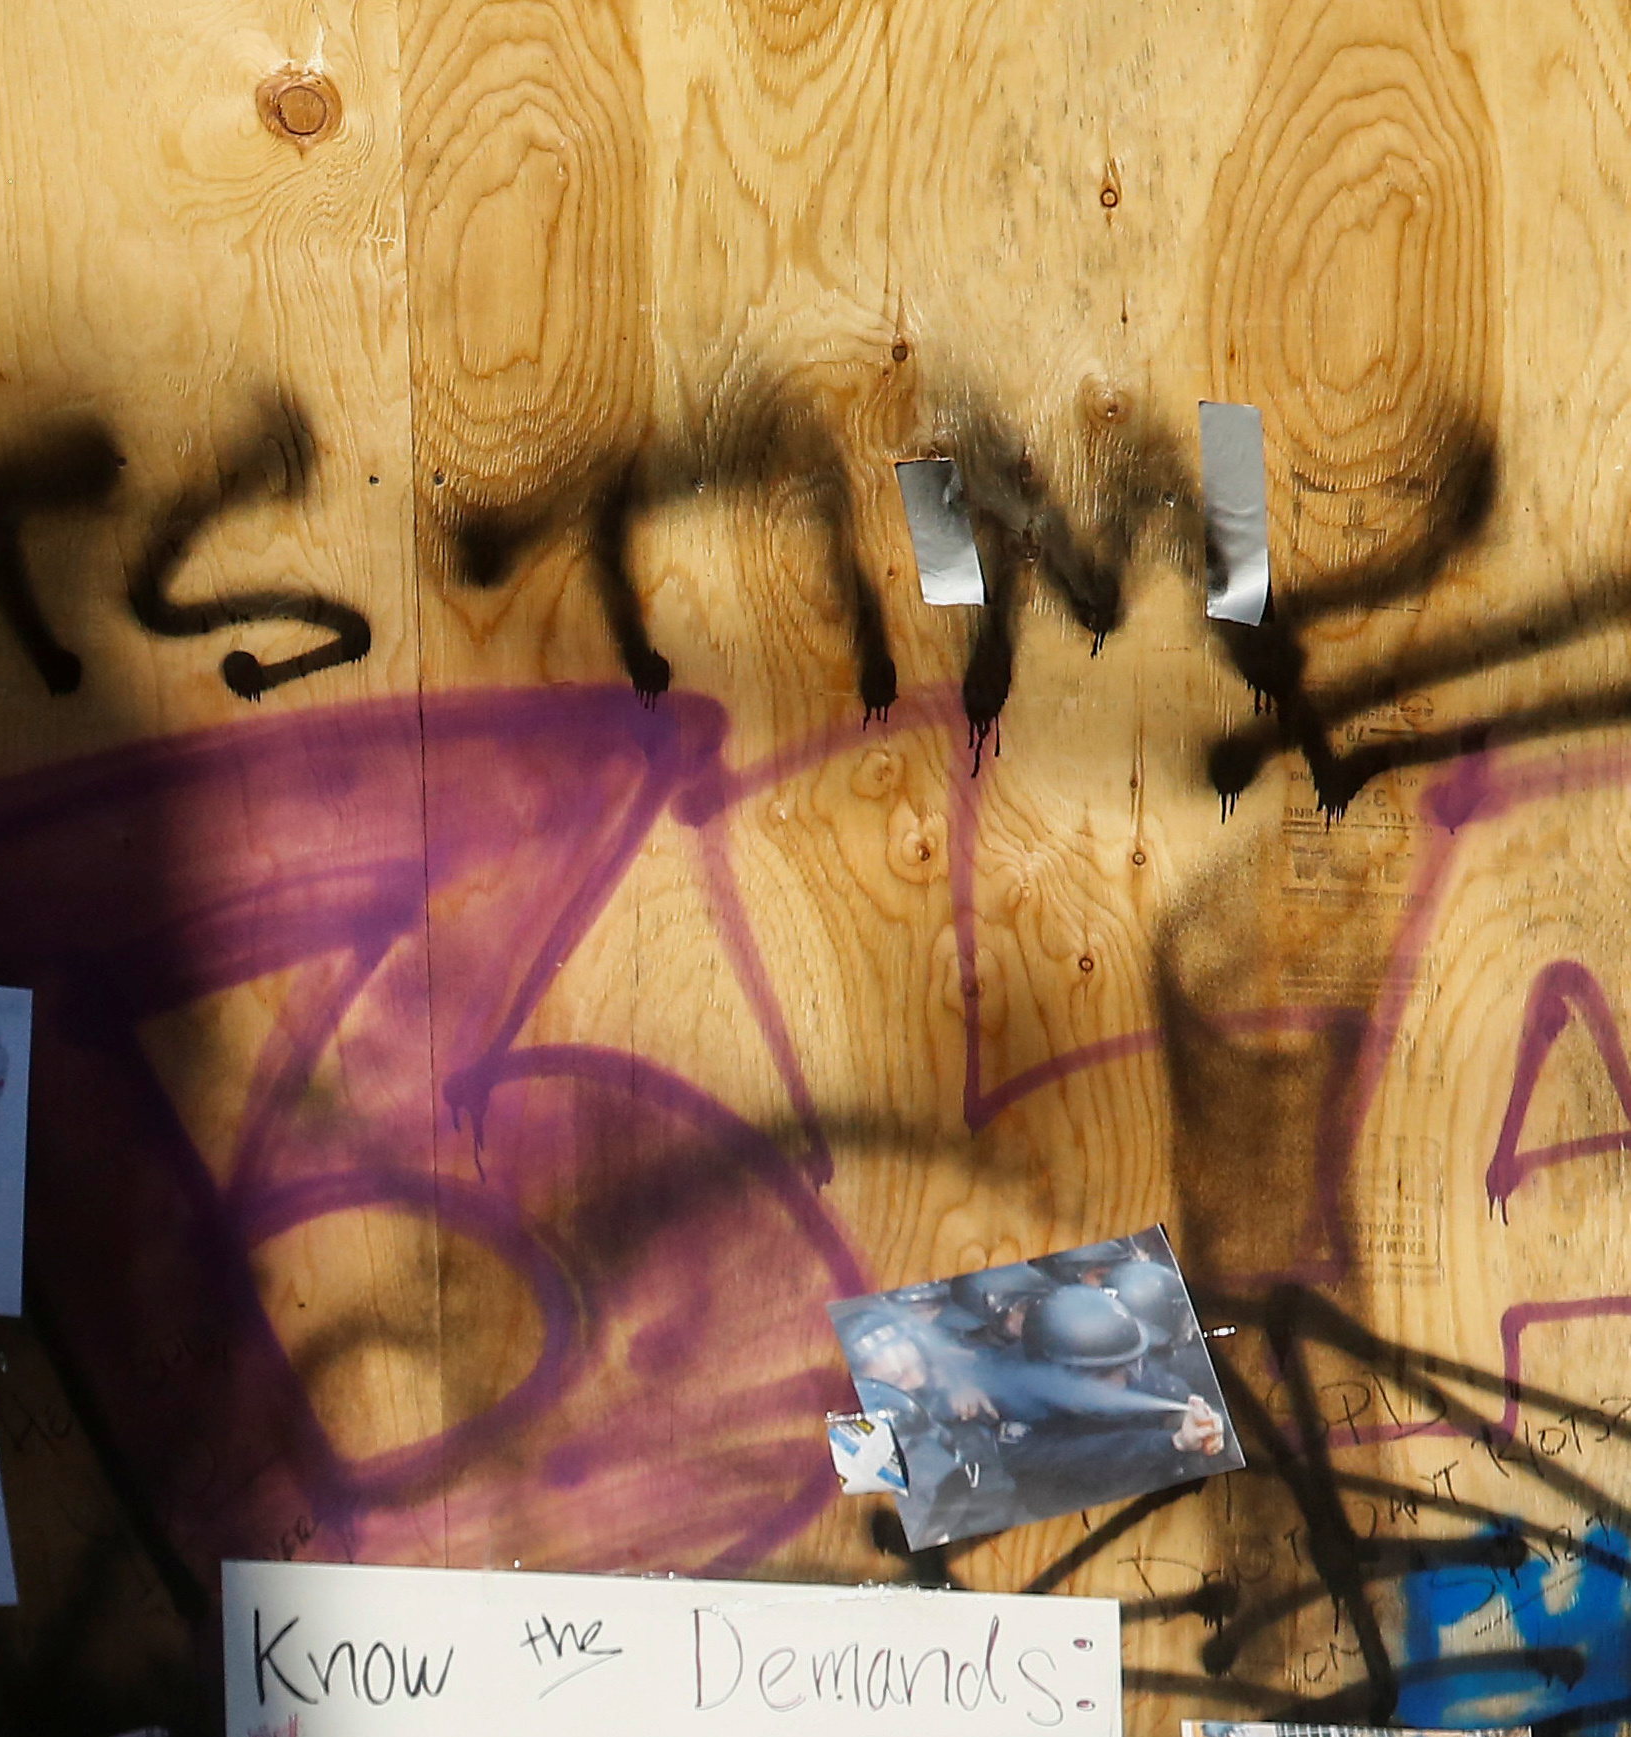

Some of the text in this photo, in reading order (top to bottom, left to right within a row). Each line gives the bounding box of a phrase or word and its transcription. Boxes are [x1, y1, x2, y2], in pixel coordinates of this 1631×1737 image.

[254, 1608, 1095, 1726] Know the Demands:
